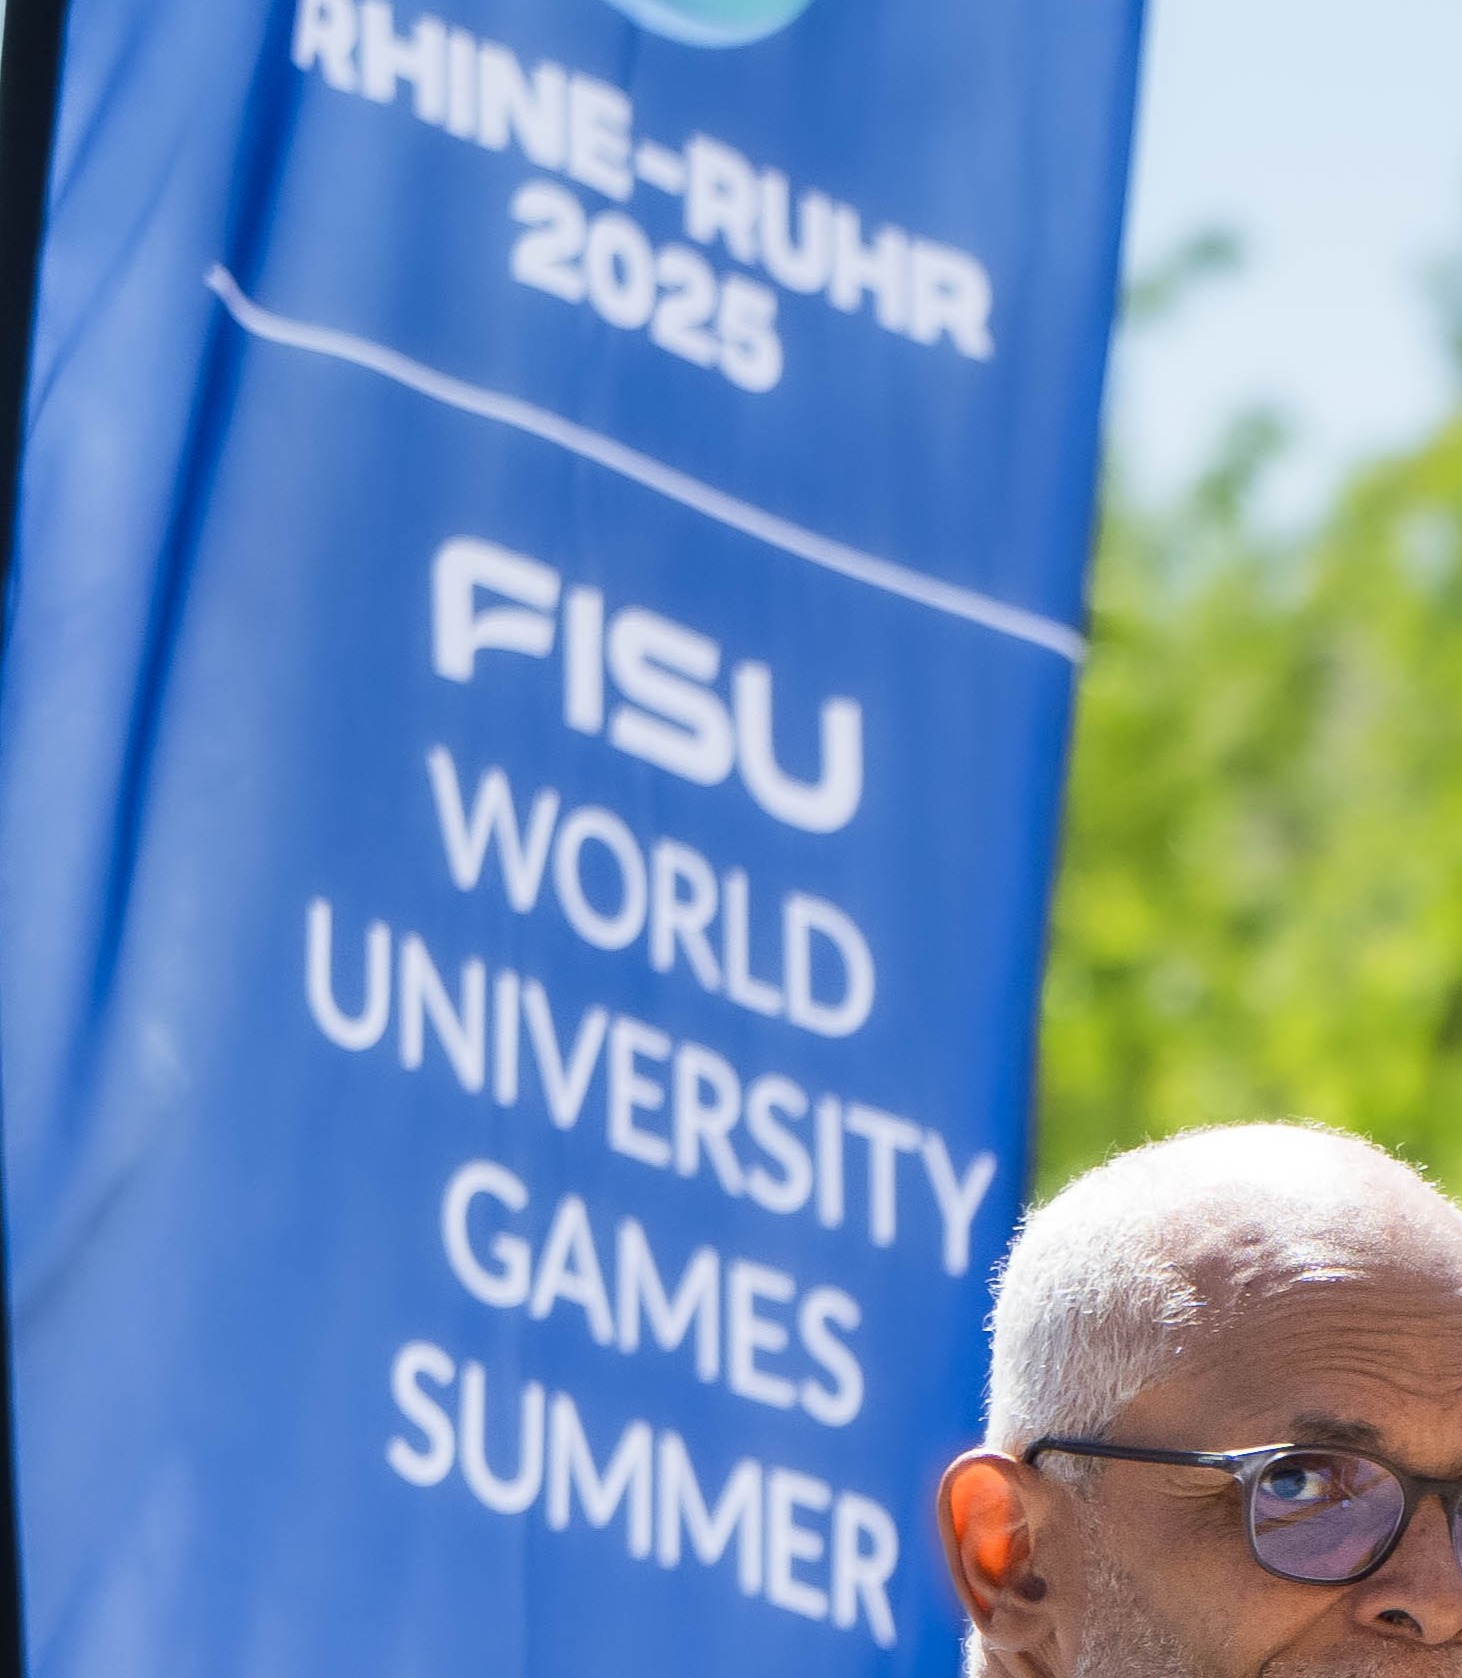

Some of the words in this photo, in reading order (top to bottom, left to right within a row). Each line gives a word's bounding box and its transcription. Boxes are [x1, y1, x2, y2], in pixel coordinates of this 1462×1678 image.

[509, 180, 784, 393] 2025
[432, 535, 861, 834] FISU
[425, 743, 876, 1038] WORLD
[305, 897, 997, 1277] UNIVERSITY
[441, 1159, 865, 1427] GAMES
[387, 1339, 899, 1649] SUMMER
